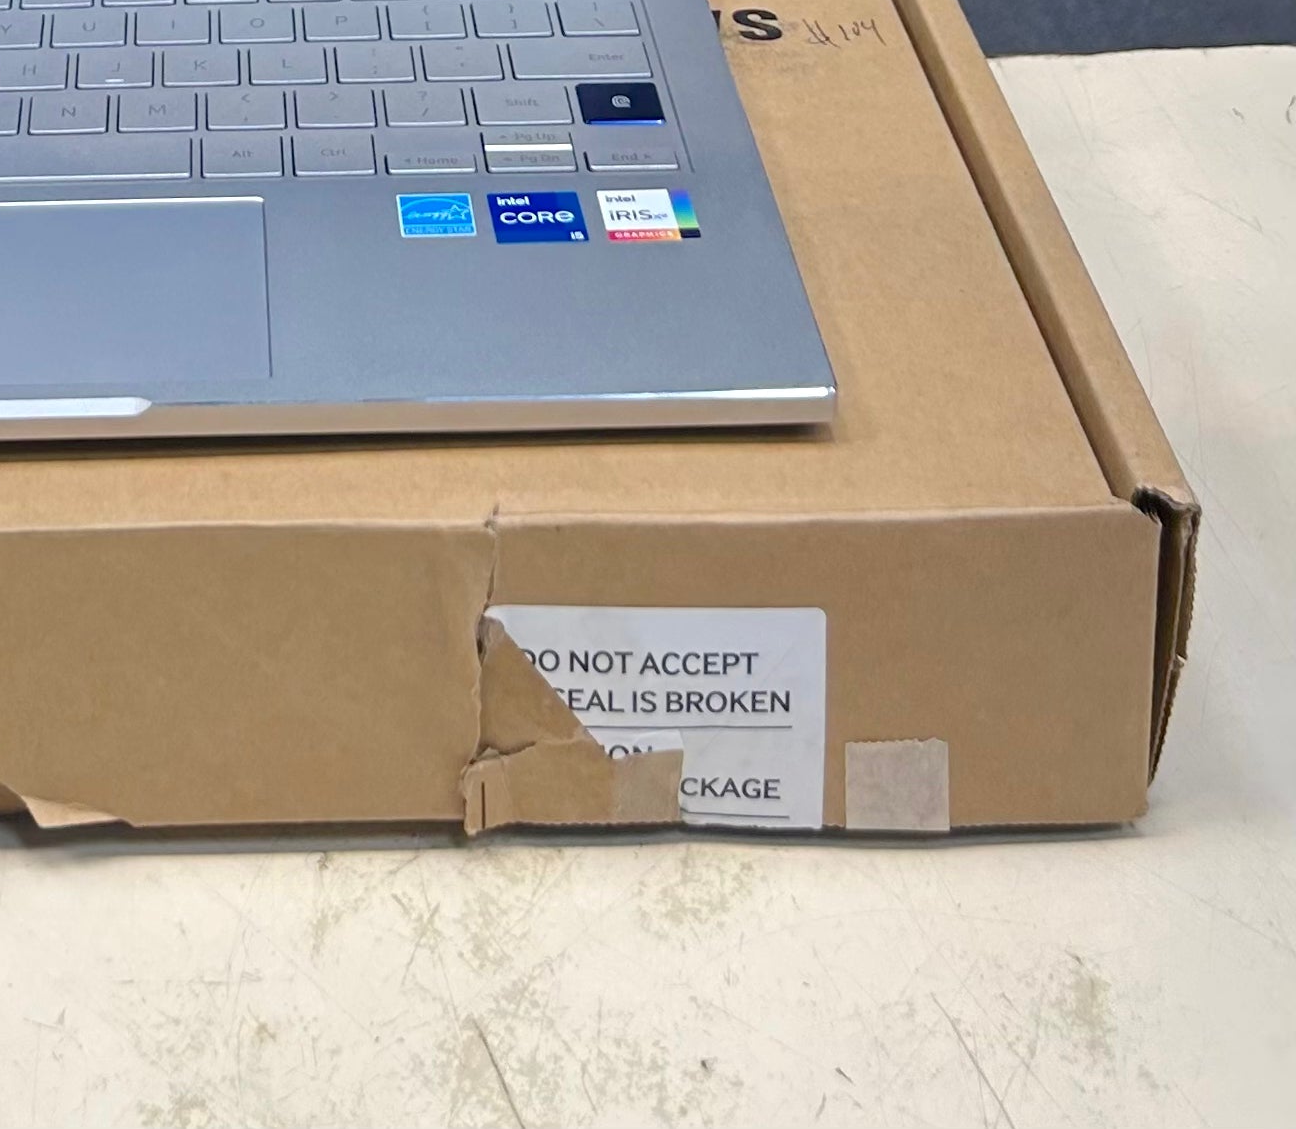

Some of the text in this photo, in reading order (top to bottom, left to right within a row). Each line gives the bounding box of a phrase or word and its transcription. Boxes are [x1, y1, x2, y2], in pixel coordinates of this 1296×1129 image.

[250, 17, 265, 28] O
[335, 15, 348, 25] P
[0, 24, 13, 34] Y
[82, 22, 96, 32] U
[22, 64, 37, 75] H
[194, 60, 208, 71] K
[282, 59, 292, 69] L
[61, 107, 76, 118] N
[148, 104, 167, 116] M
[569, 650, 633, 674] NOT
[639, 651, 759, 675] ACCEPT
[554, 687, 791, 713] EAL IS BROKEN
[680, 776, 781, 800] CKAGE
